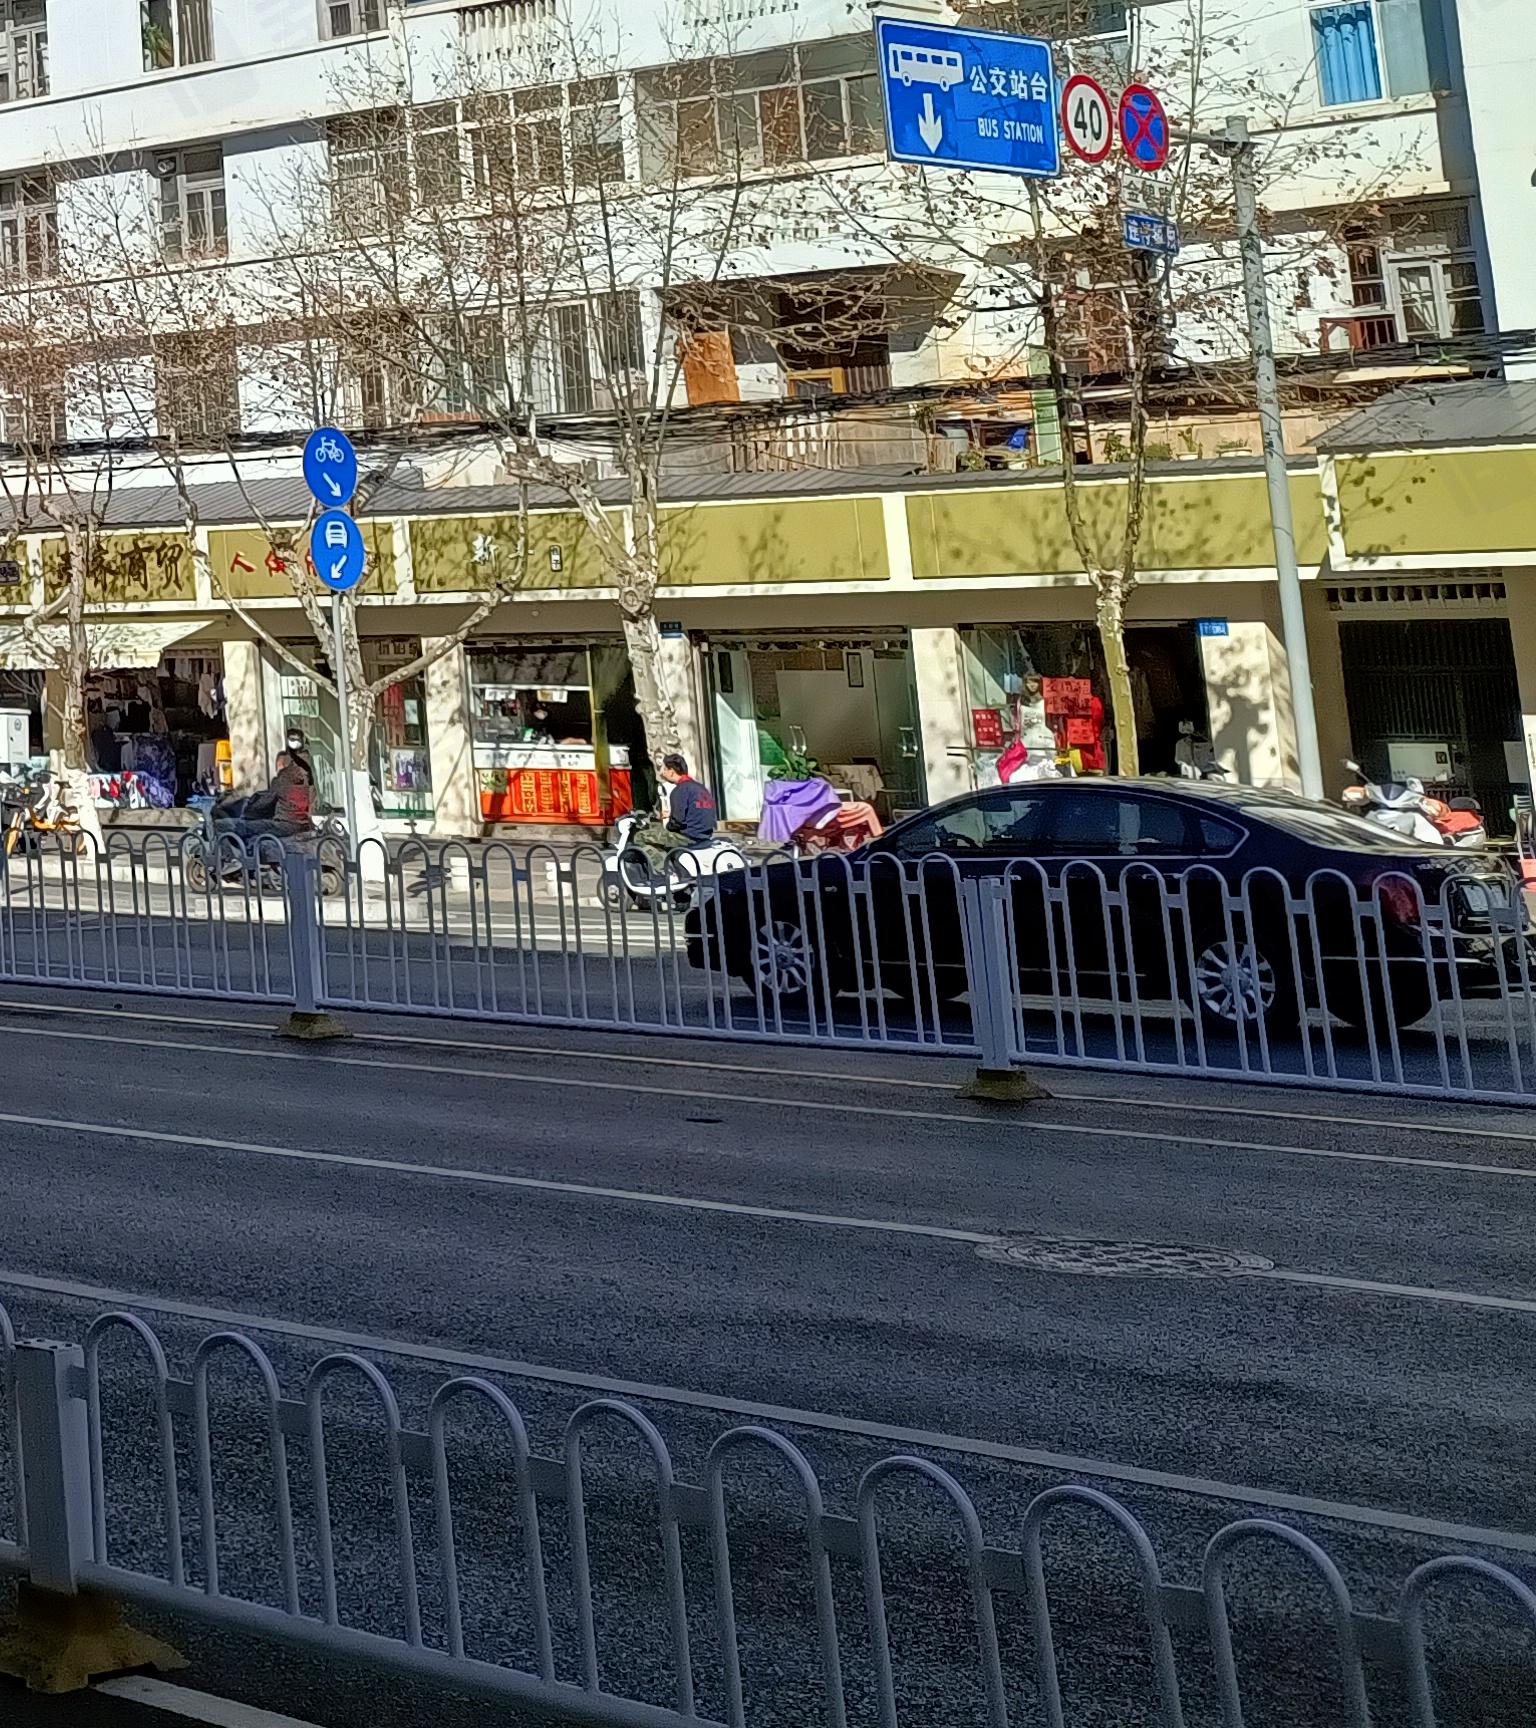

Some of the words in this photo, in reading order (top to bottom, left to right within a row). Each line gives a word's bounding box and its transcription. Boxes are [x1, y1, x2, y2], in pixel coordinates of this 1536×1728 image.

[969, 64, 1048, 103] 公交站台
[978, 117, 999, 137] BUS
[1003, 120, 1044, 144] STATION
[1073, 96, 1103, 141] 40
